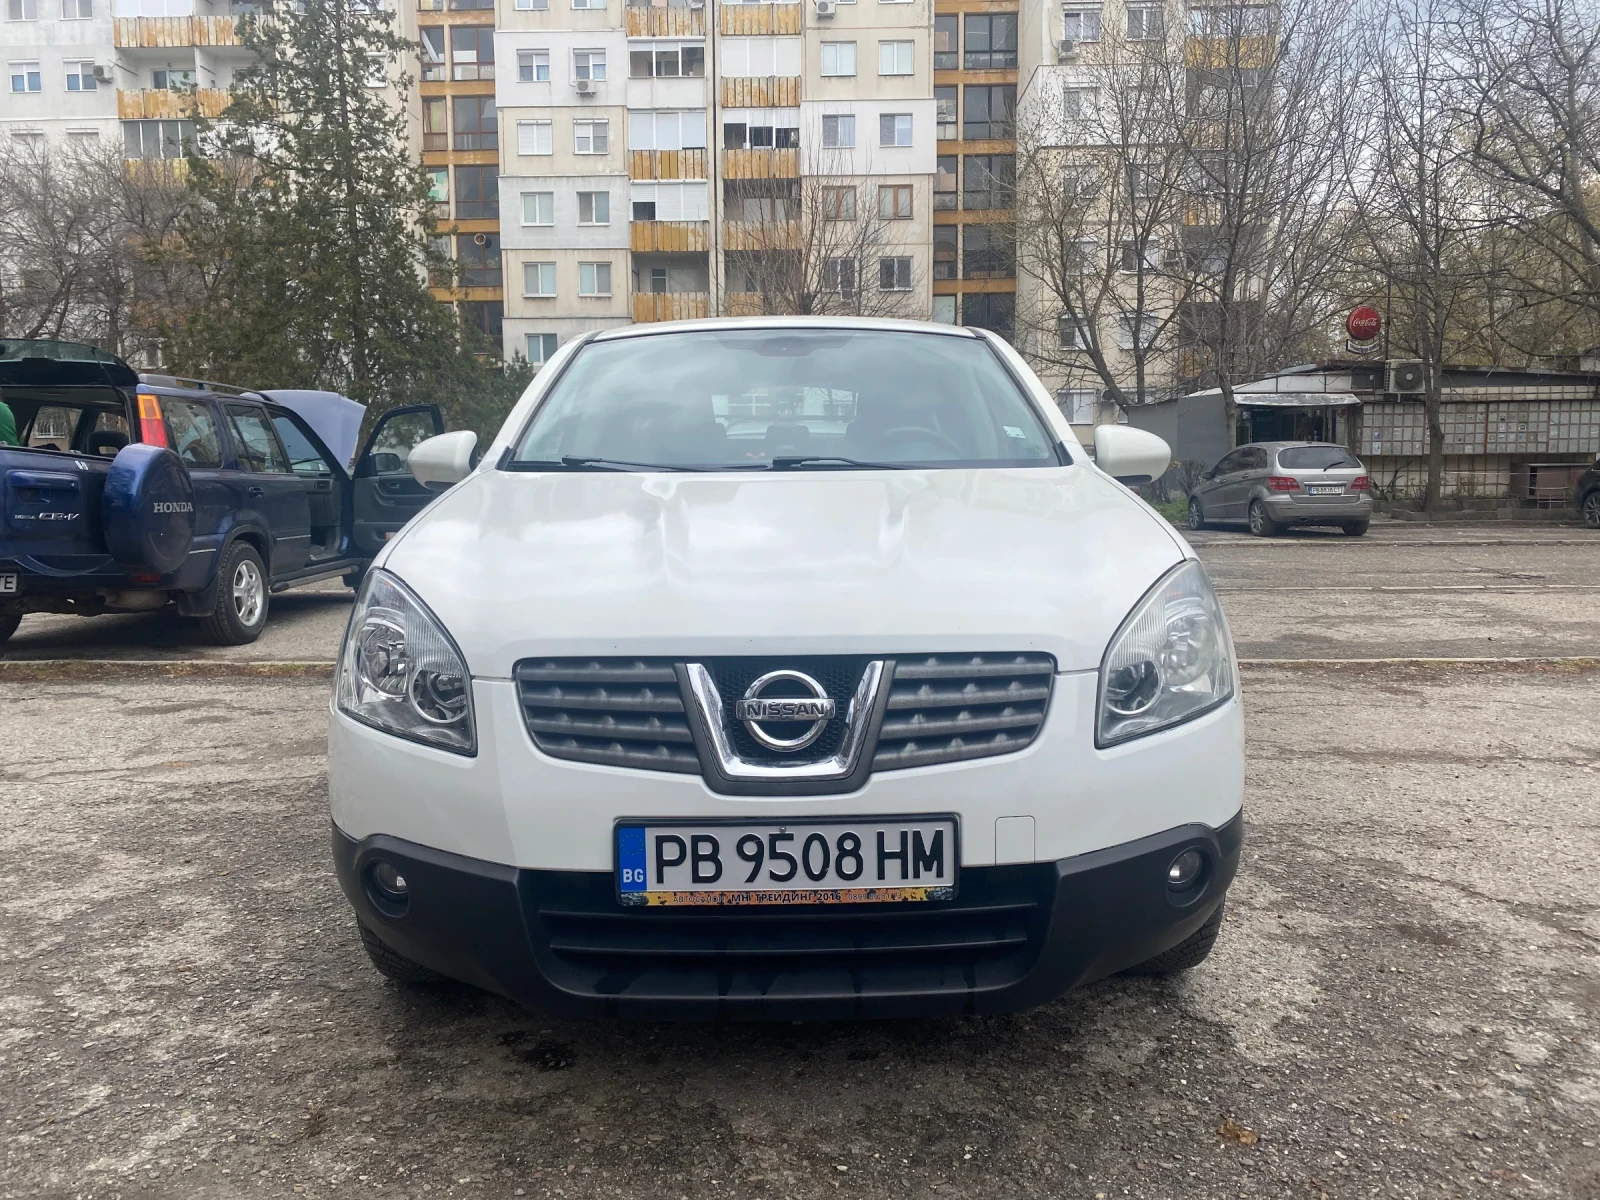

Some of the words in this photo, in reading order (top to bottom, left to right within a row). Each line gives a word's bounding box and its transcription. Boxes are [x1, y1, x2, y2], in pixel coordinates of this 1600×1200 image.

[153, 501, 194, 513] HONDA
[746, 701, 825, 717] NISSAN
[655, 833, 723, 884] PB
[736, 831, 864, 883] 9508
[876, 828, 945, 881] HM
[622, 868, 645, 883] BG
[755, 891, 814, 904] ТРЕЙДИНГ
[816, 892, 842, 901] 2016
